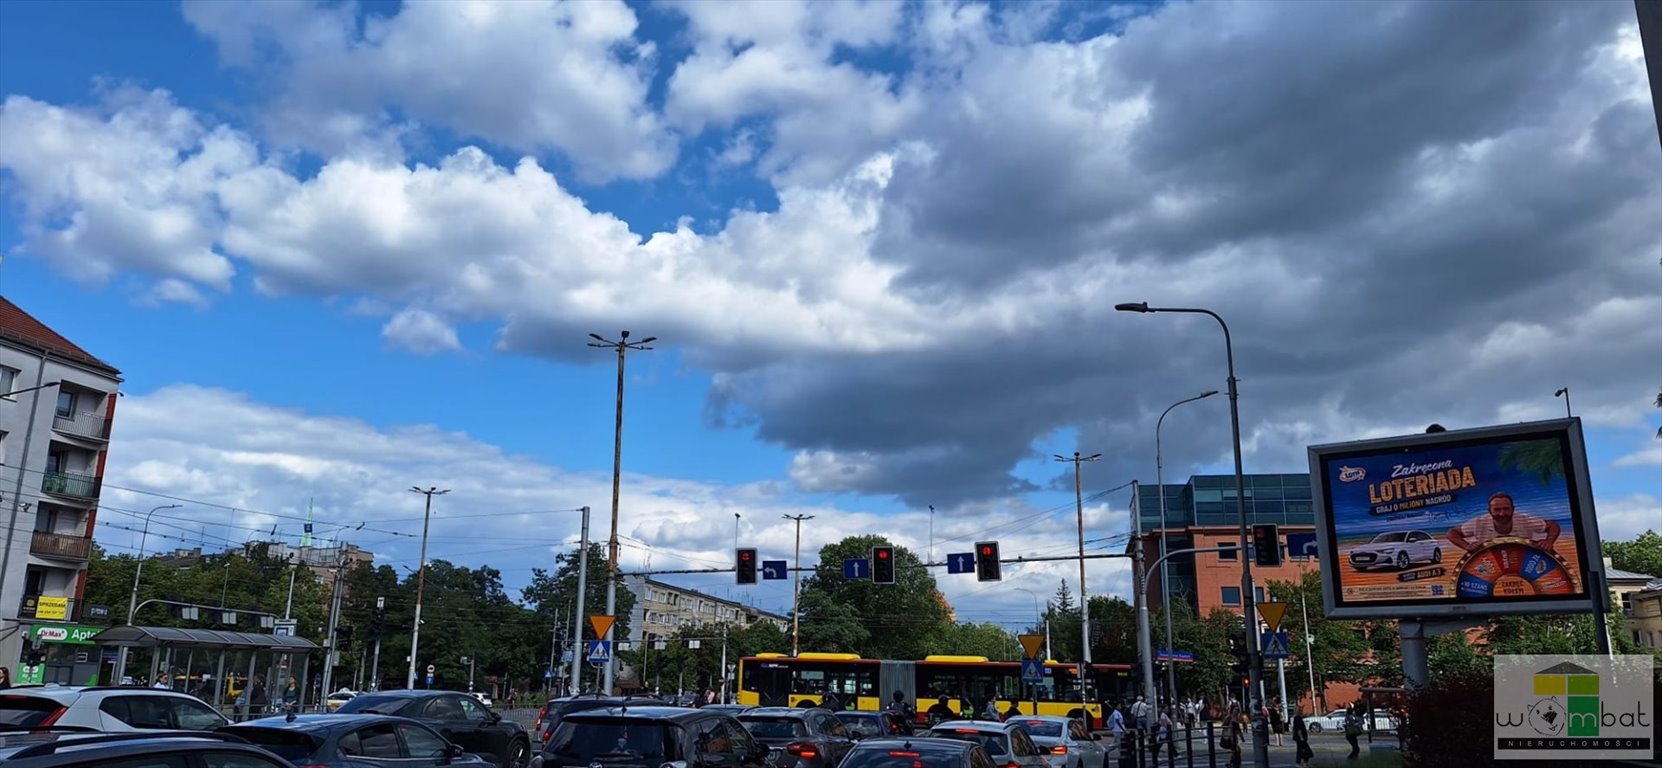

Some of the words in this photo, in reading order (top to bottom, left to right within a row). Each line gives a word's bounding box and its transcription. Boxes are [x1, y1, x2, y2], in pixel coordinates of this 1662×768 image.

[1391, 459, 1453, 478] Zakręcona
[1369, 466, 1476, 504] LOTERIADA
[1376, 505, 1392, 514] GRAJ
[1399, 499, 1424, 510] MILIONY
[1425, 494, 1452, 507] NAGRÓD
[1416, 570, 1431, 578] AUDI
